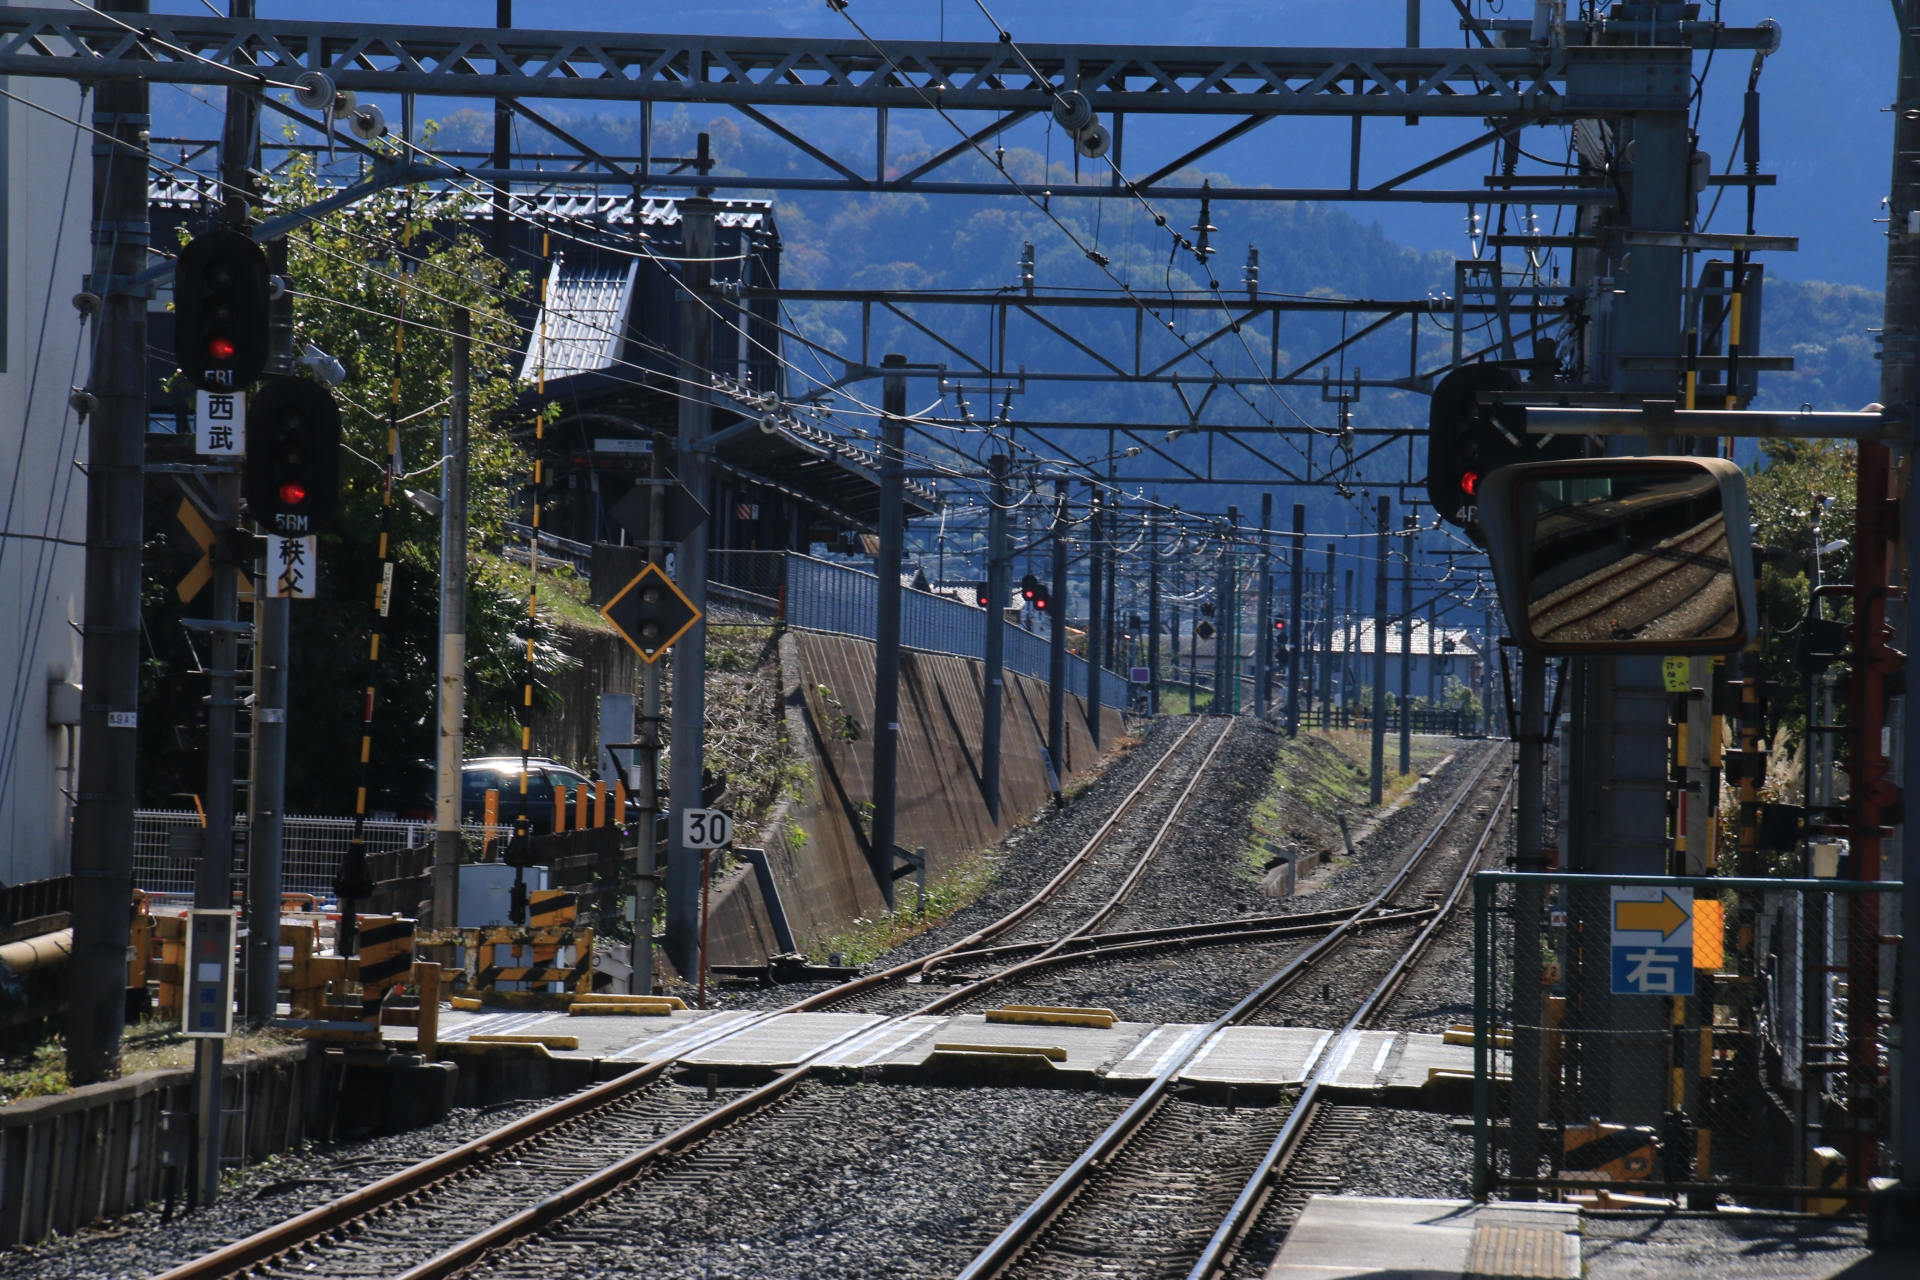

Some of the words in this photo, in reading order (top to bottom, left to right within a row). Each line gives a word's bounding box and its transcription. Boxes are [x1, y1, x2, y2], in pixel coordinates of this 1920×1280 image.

[208, 395, 234, 450] 西武
[279, 540, 305, 594] 秩父
[689, 813, 726, 845] 30
[1625, 949, 1680, 993] 右
